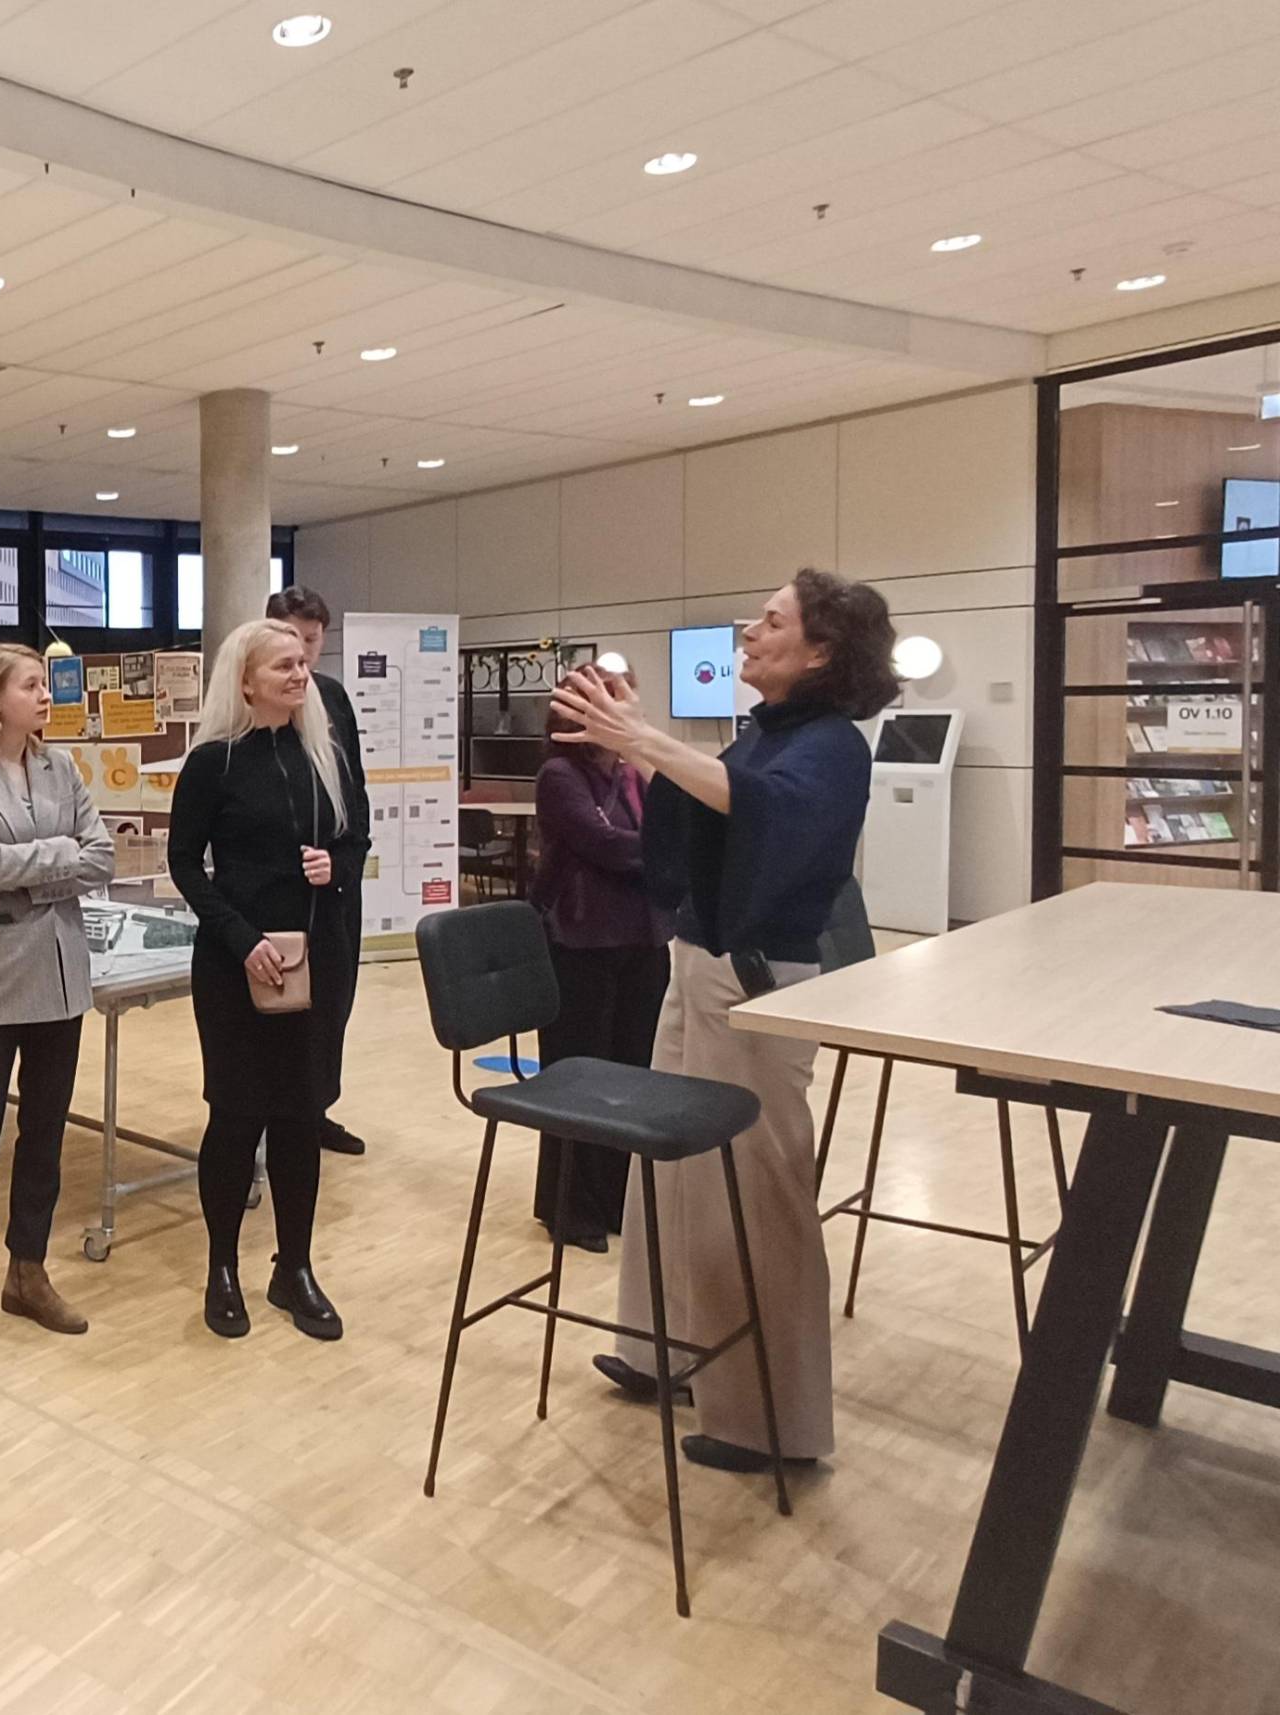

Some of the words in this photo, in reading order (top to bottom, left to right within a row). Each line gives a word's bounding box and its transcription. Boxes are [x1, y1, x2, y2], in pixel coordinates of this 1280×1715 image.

[1179, 707, 1200, 719] OV
[1205, 707, 1233, 719] 1.10
[111, 768, 127, 786] C
